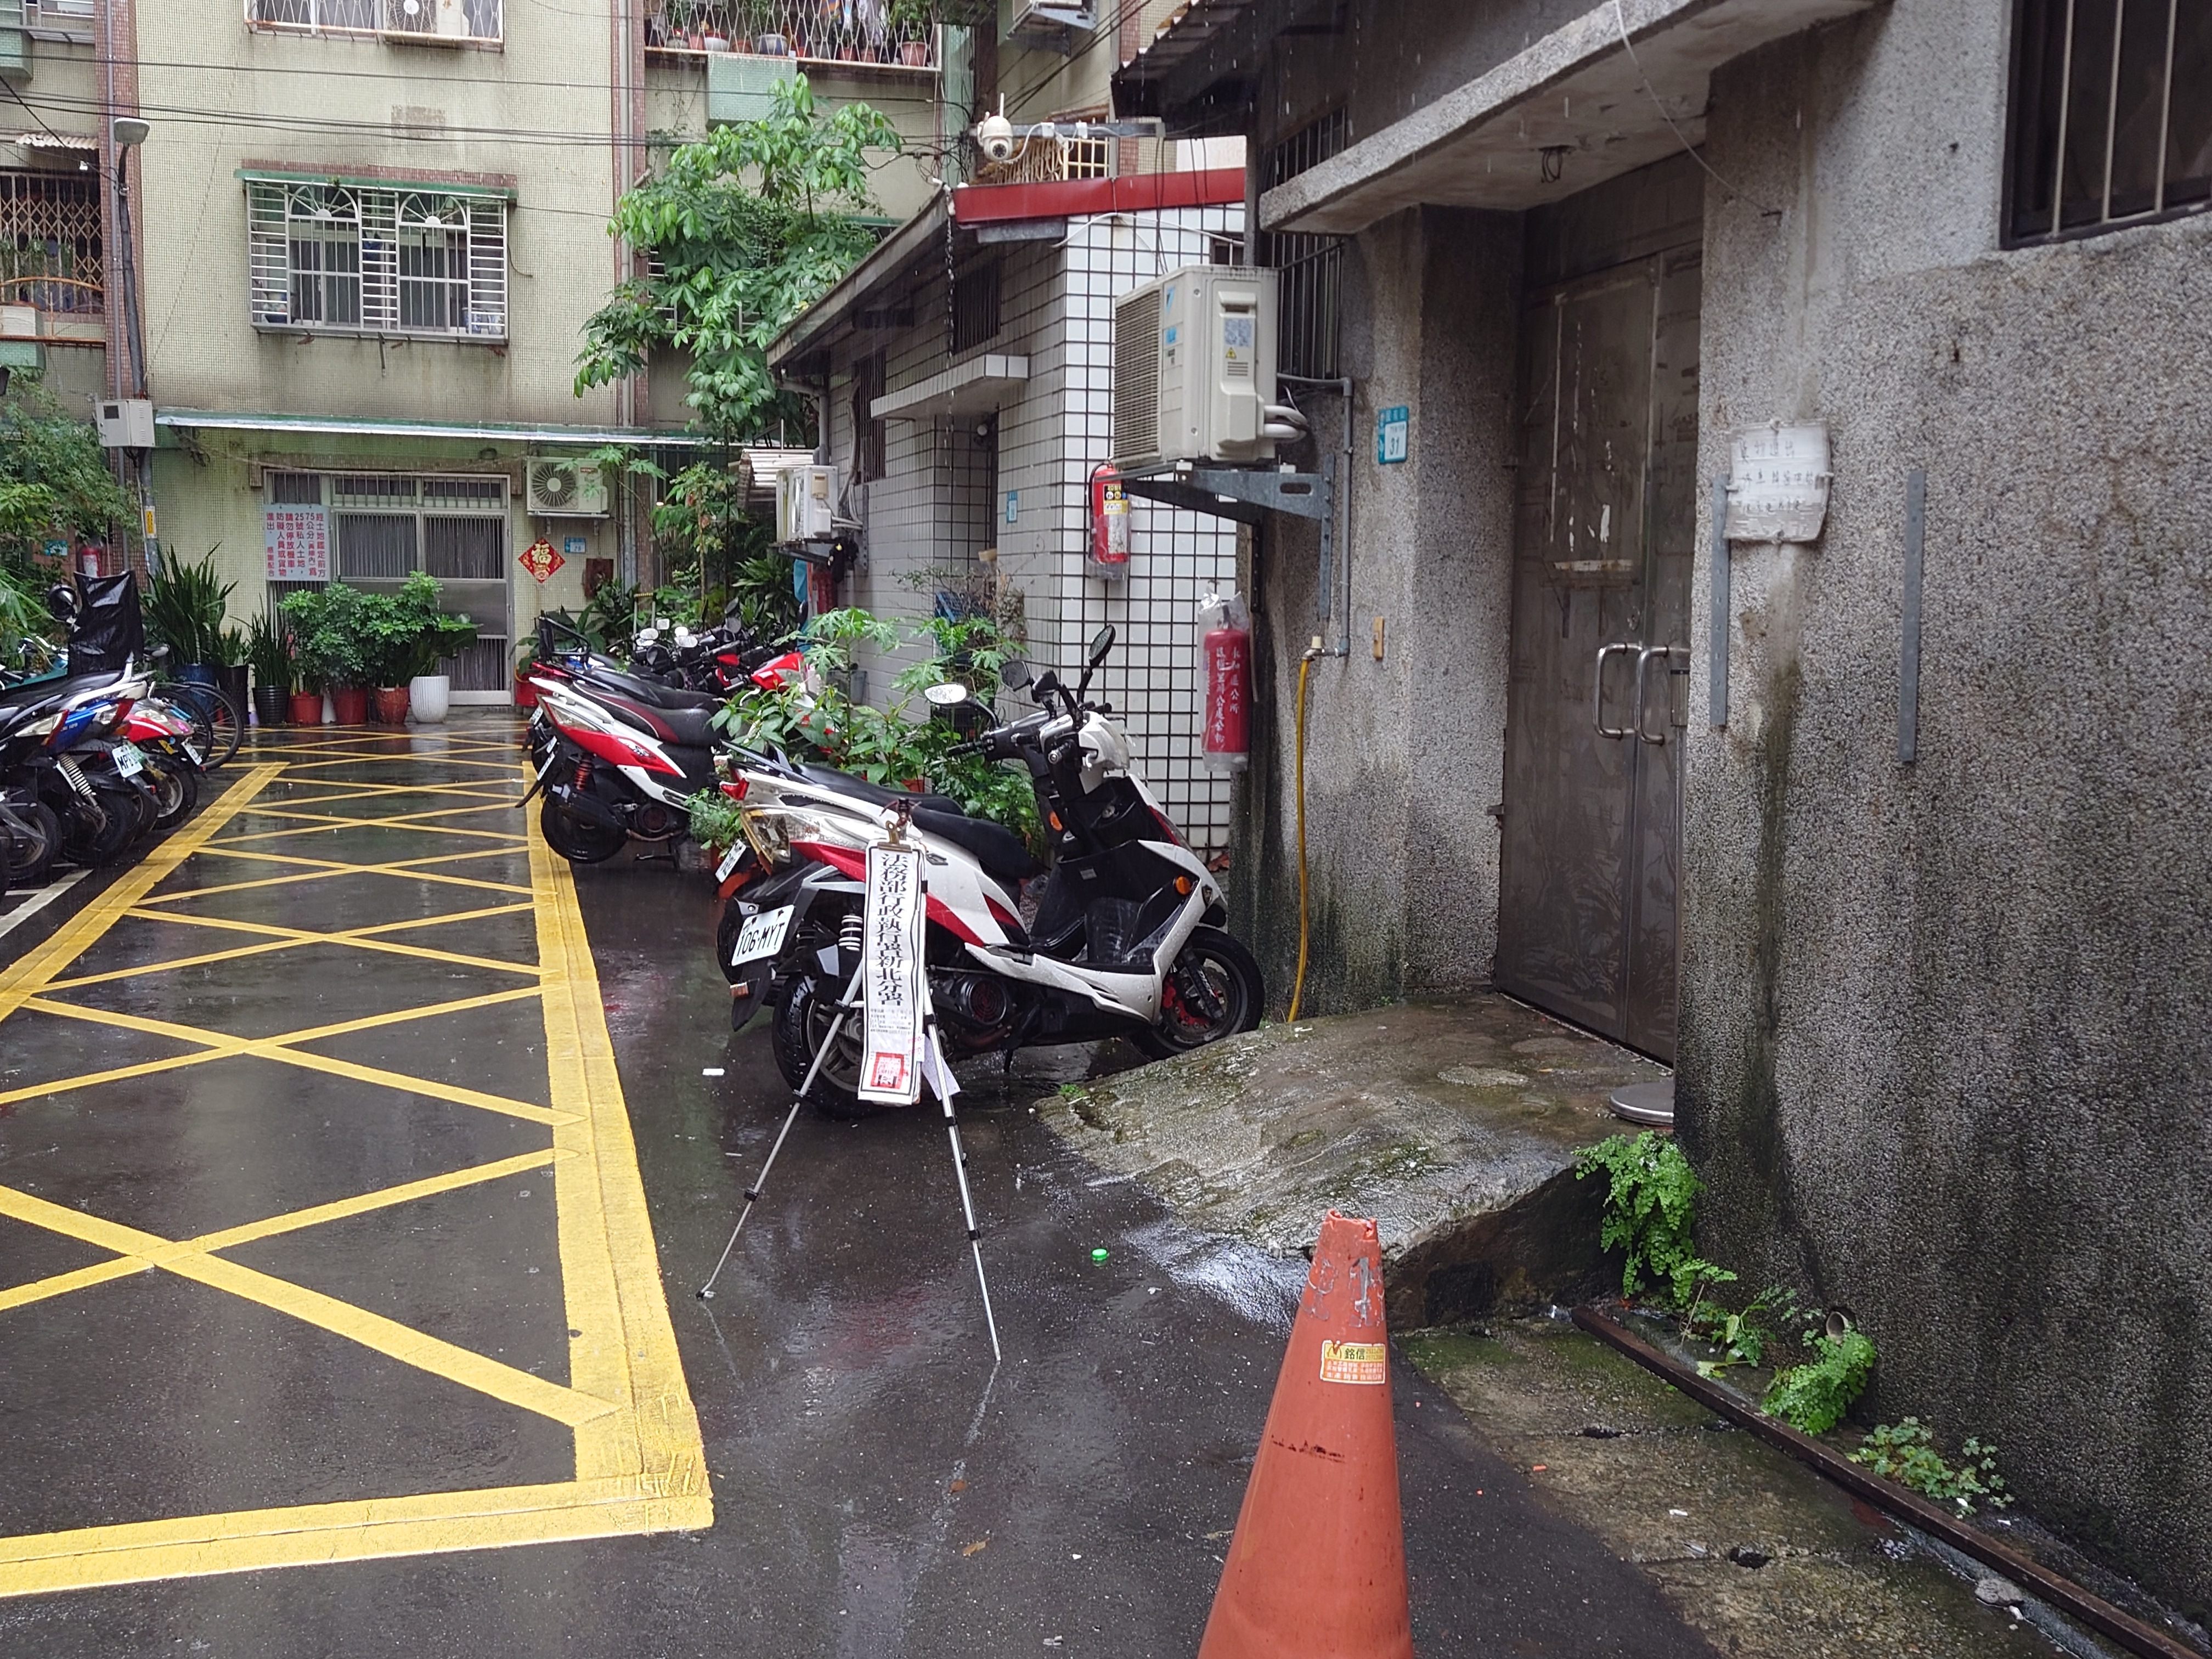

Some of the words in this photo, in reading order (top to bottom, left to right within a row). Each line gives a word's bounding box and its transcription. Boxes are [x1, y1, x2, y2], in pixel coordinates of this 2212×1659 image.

[737, 922, 785, 957] 106-MYT
[876, 853, 908, 1006] 法務部行政執行署新北分署
[1345, 1348, 1365, 1360] 銘信
